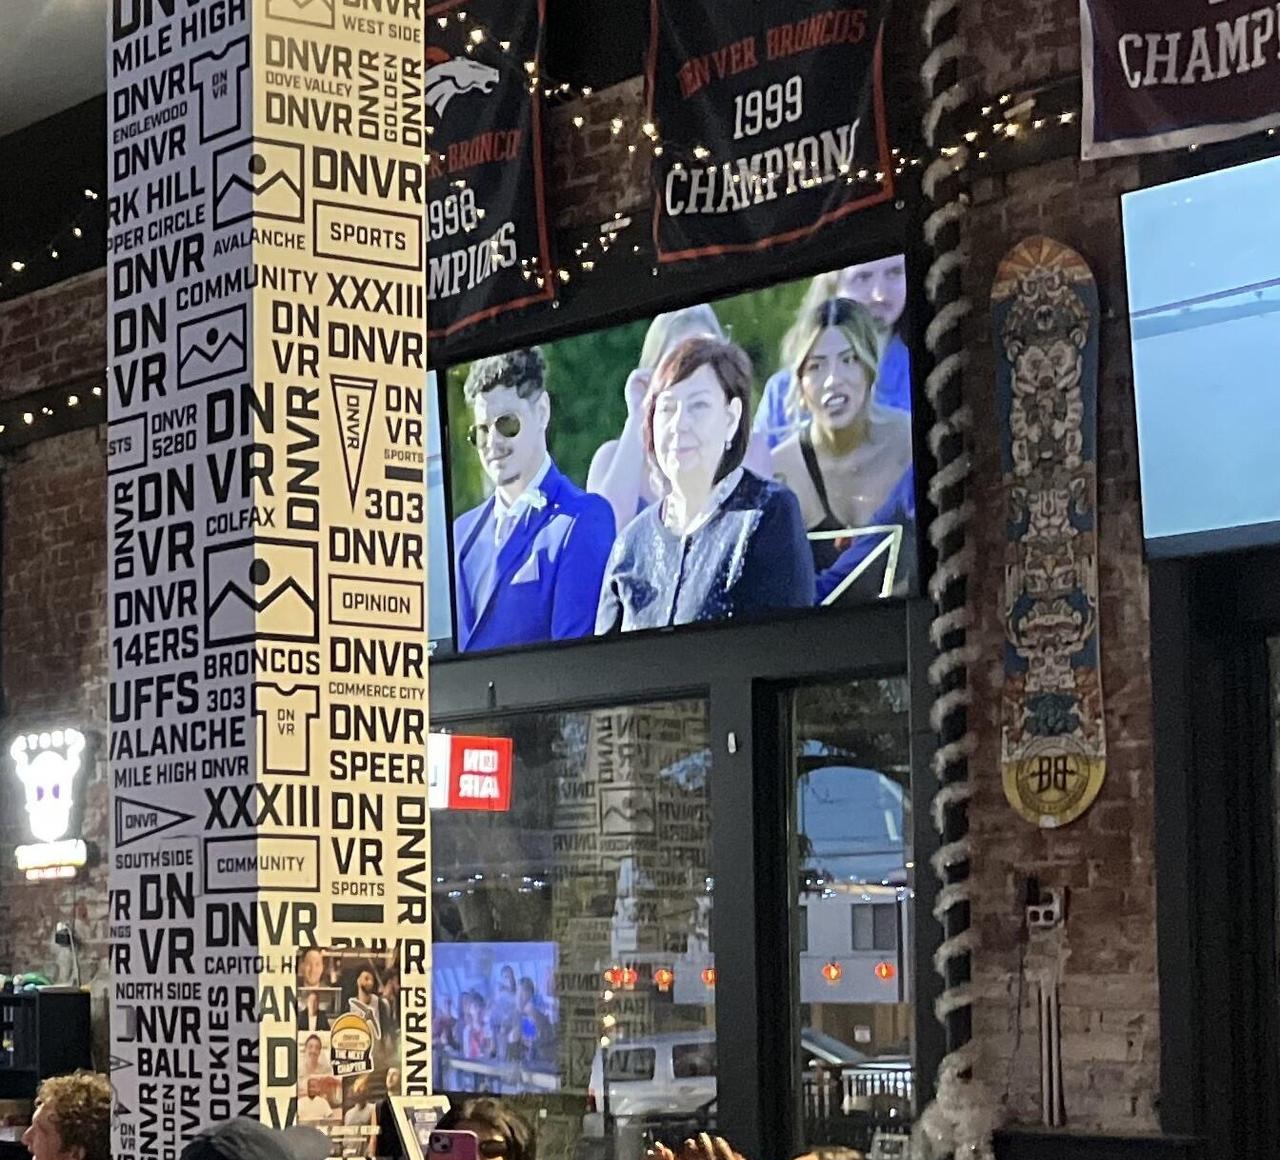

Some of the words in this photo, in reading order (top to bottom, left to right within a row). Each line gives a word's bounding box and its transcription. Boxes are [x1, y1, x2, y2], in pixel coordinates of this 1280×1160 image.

[112, 24, 173, 78] MILE
[181, 3, 246, 47] HIGH
[343, 14, 385, 36] WEST
[388, 22, 422, 43] SIDE
[212, 83, 228, 99] VR
[265, 70, 300, 89] DOVE
[303, 75, 352, 97] VALLEY
[385, 53, 398, 142] GOLDEN
[403, 57, 422, 148] DNVR
[733, 74, 803, 140] 1999
[113, 101, 188, 145] ENGLEWOOD
[449, 128, 522, 173] BRONCO
[665, 117, 860, 217] CHAMPION
[147, 165, 205, 215] HILL
[313, 146, 423, 205] DNVR
[148, 204, 205, 242] CIRCLE
[330, 222, 407, 251] SPORTS
[213, 227, 306, 258] AVALANCHE
[176, 263, 318, 312] COMMUNITY
[327, 271, 424, 319] XXXIII
[272, 300, 320, 339] DN
[114, 352, 167, 408] VR
[152, 429, 197, 459] 5280
[385, 416, 423, 447] VR
[287, 386, 320, 532] DNVR
[384, 448, 424, 464] SPORTS
[206, 506, 275, 537] COLFAX
[364, 487, 424, 524] 303
[115, 479, 134, 580] DNVR
[115, 579, 197, 629] DNVR
[342, 592, 411, 614] OPINION
[112, 624, 200, 670] 14ERS
[203, 646, 320, 680] BRONCOS
[206, 686, 245, 713] 303
[329, 682, 397, 699] COMMERCE
[399, 687, 425, 700] CITY
[277, 708, 295, 722] DN
[115, 766, 151, 788] MILE
[157, 760, 196, 785] HIGH
[202, 755, 248, 780] DNVR
[330, 751, 425, 784] SPEER
[204, 784, 320, 830] XXXIII
[116, 851, 160, 869] SOUTH
[162, 849, 194, 868] SIDE
[217, 856, 305, 873] COMMUNITY
[397, 796, 427, 925] DNVR
[331, 881, 385, 896] SPORTS
[206, 901, 319, 948] DNVR
[204, 954, 275, 976] CAPITOL
[116, 982, 163, 1001] NORTH
[167, 982, 202, 1000] SIDE
[138, 1048, 203, 1079] BALL
